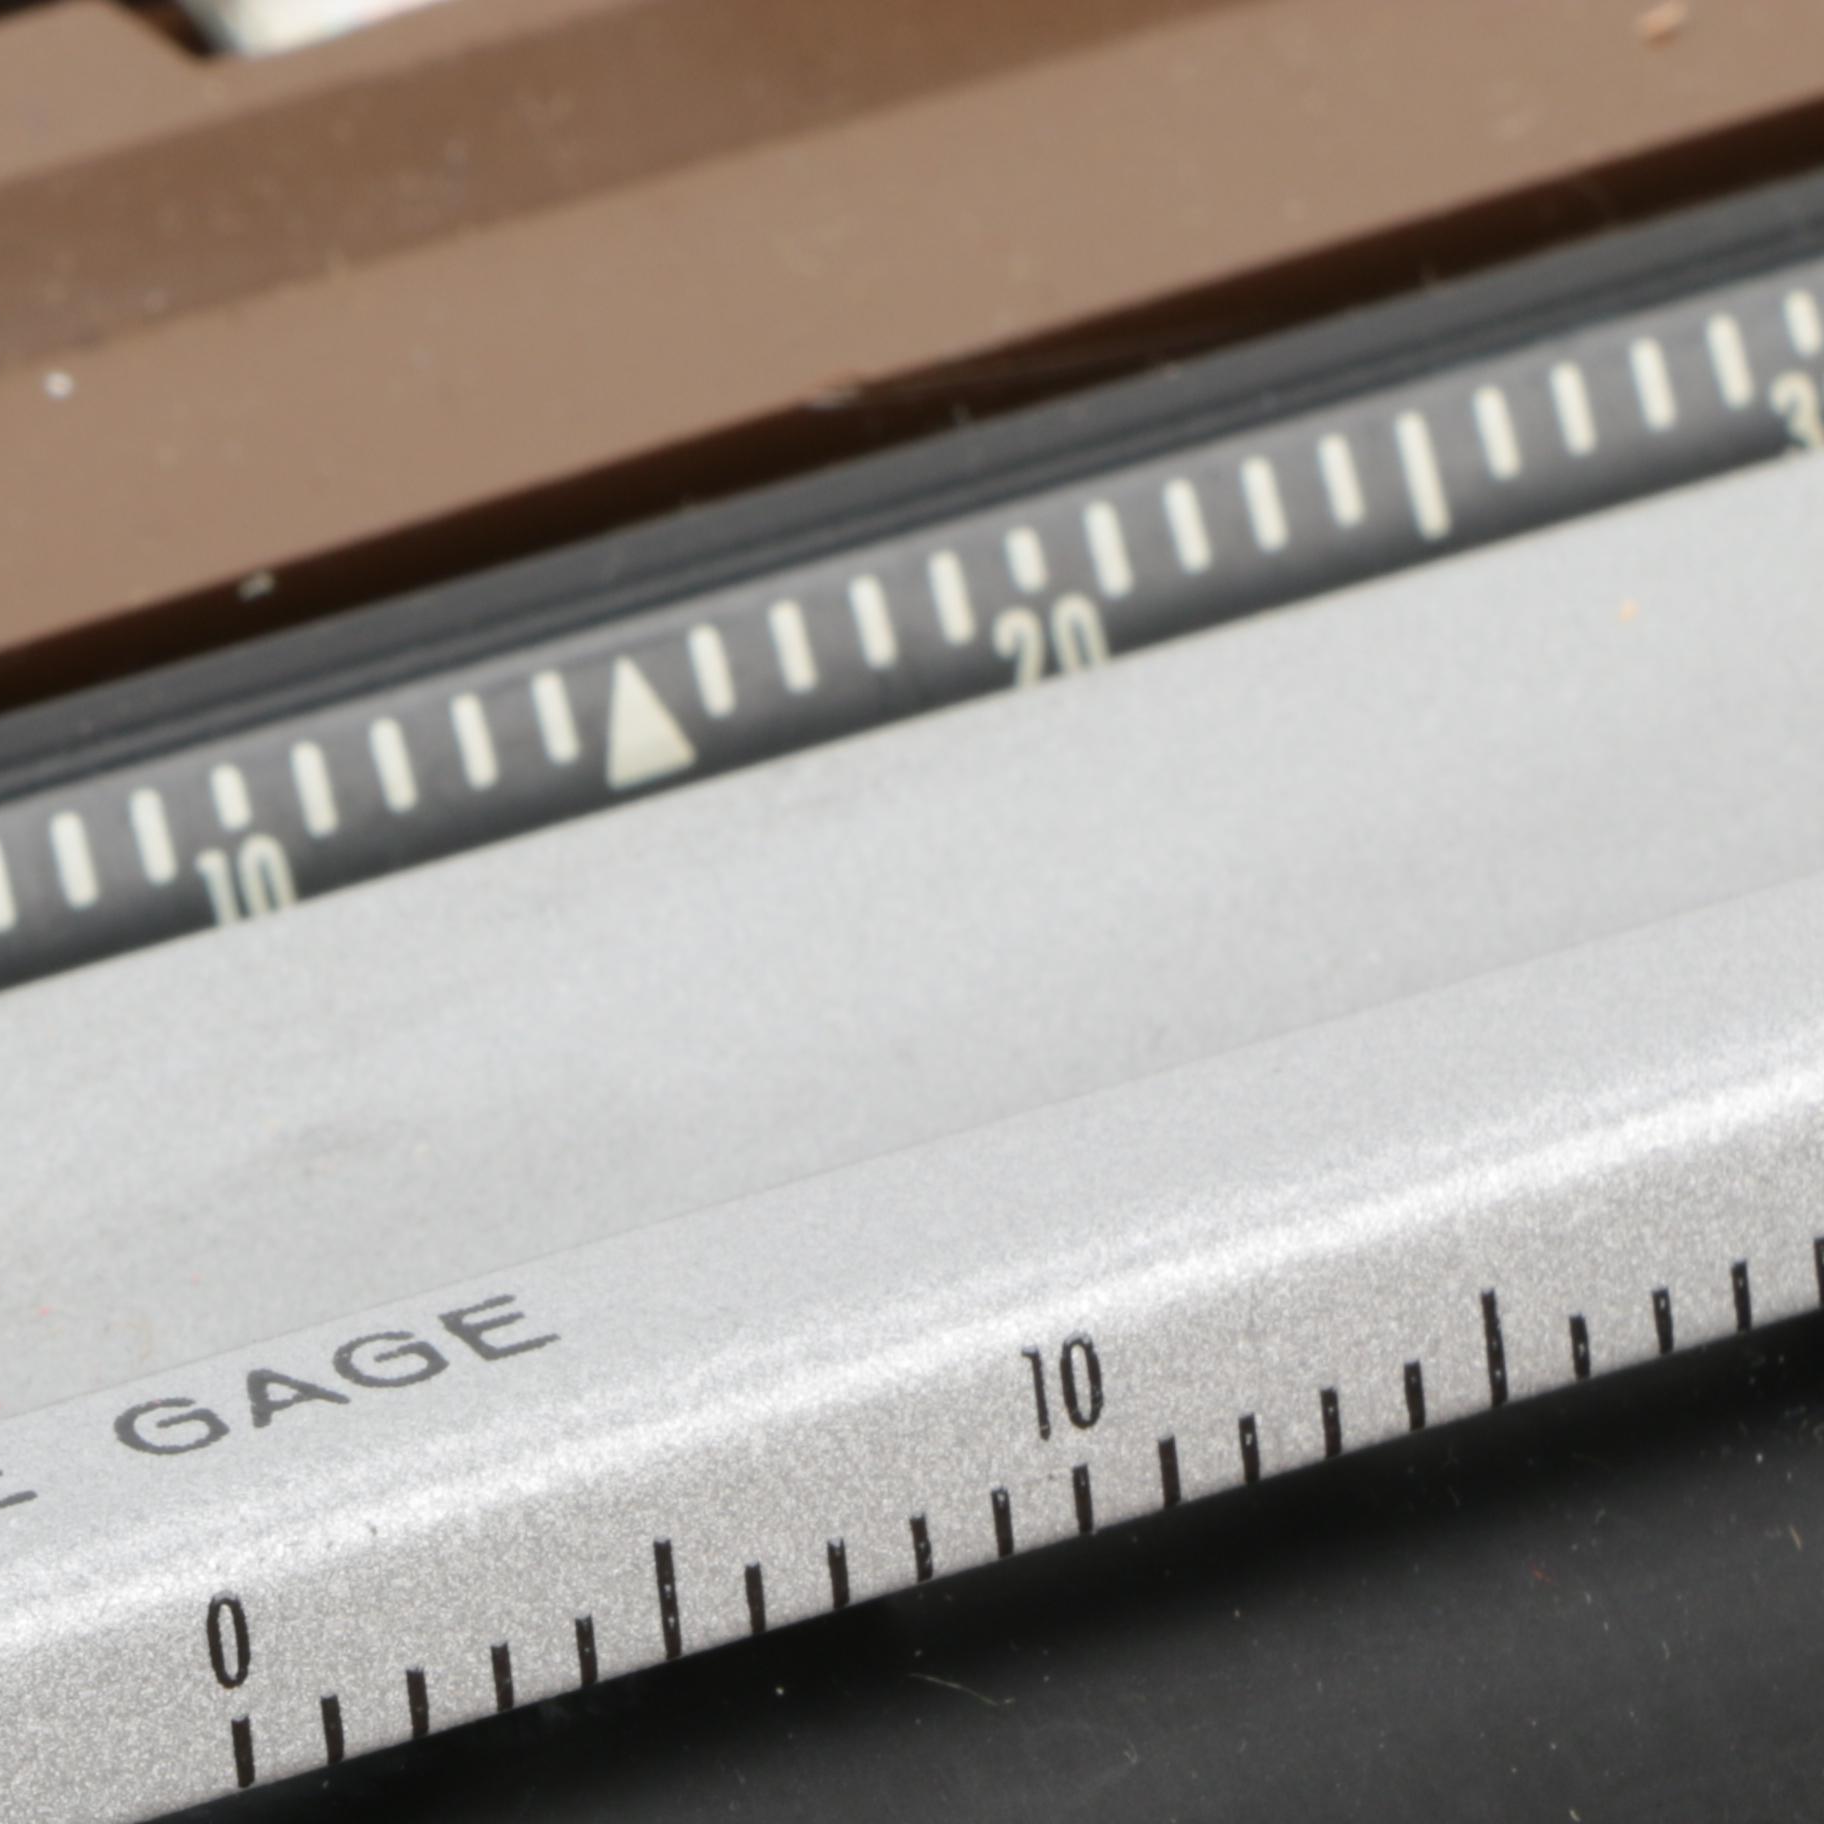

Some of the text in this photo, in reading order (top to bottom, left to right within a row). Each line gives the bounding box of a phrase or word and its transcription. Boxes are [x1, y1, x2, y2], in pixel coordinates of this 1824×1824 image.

[198, 835, 297, 922] 10
[113, 1293, 561, 1456] GAGE
[206, 1333, 1106, 1689] 0 10
